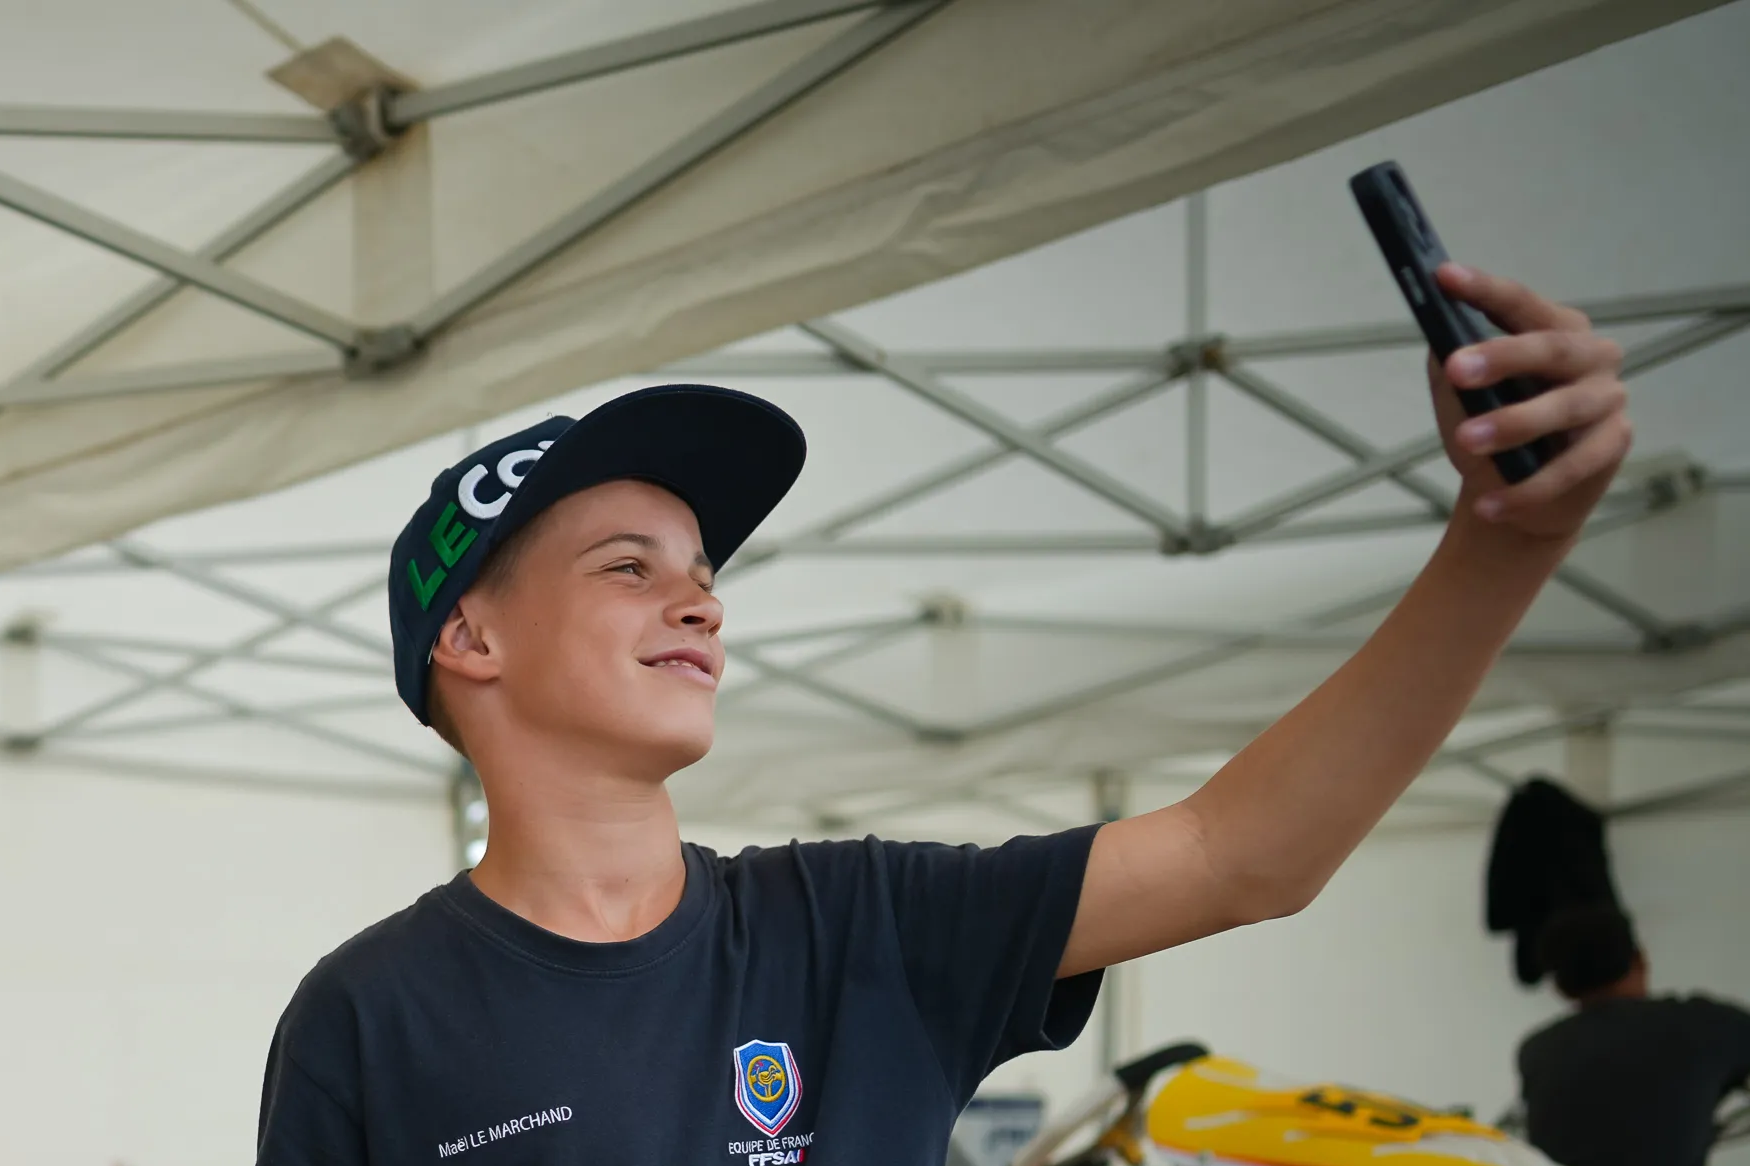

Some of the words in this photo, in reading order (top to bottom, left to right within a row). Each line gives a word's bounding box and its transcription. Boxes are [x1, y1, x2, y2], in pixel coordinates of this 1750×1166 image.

[407, 440, 555, 612] LECO
[438, 1136, 469, 1158] Maël
[469, 1130, 488, 1148] LE
[488, 1105, 573, 1142] MARCHAND
[728, 1140, 764, 1155] EQUIPE
[766, 1138, 781, 1152] DE
